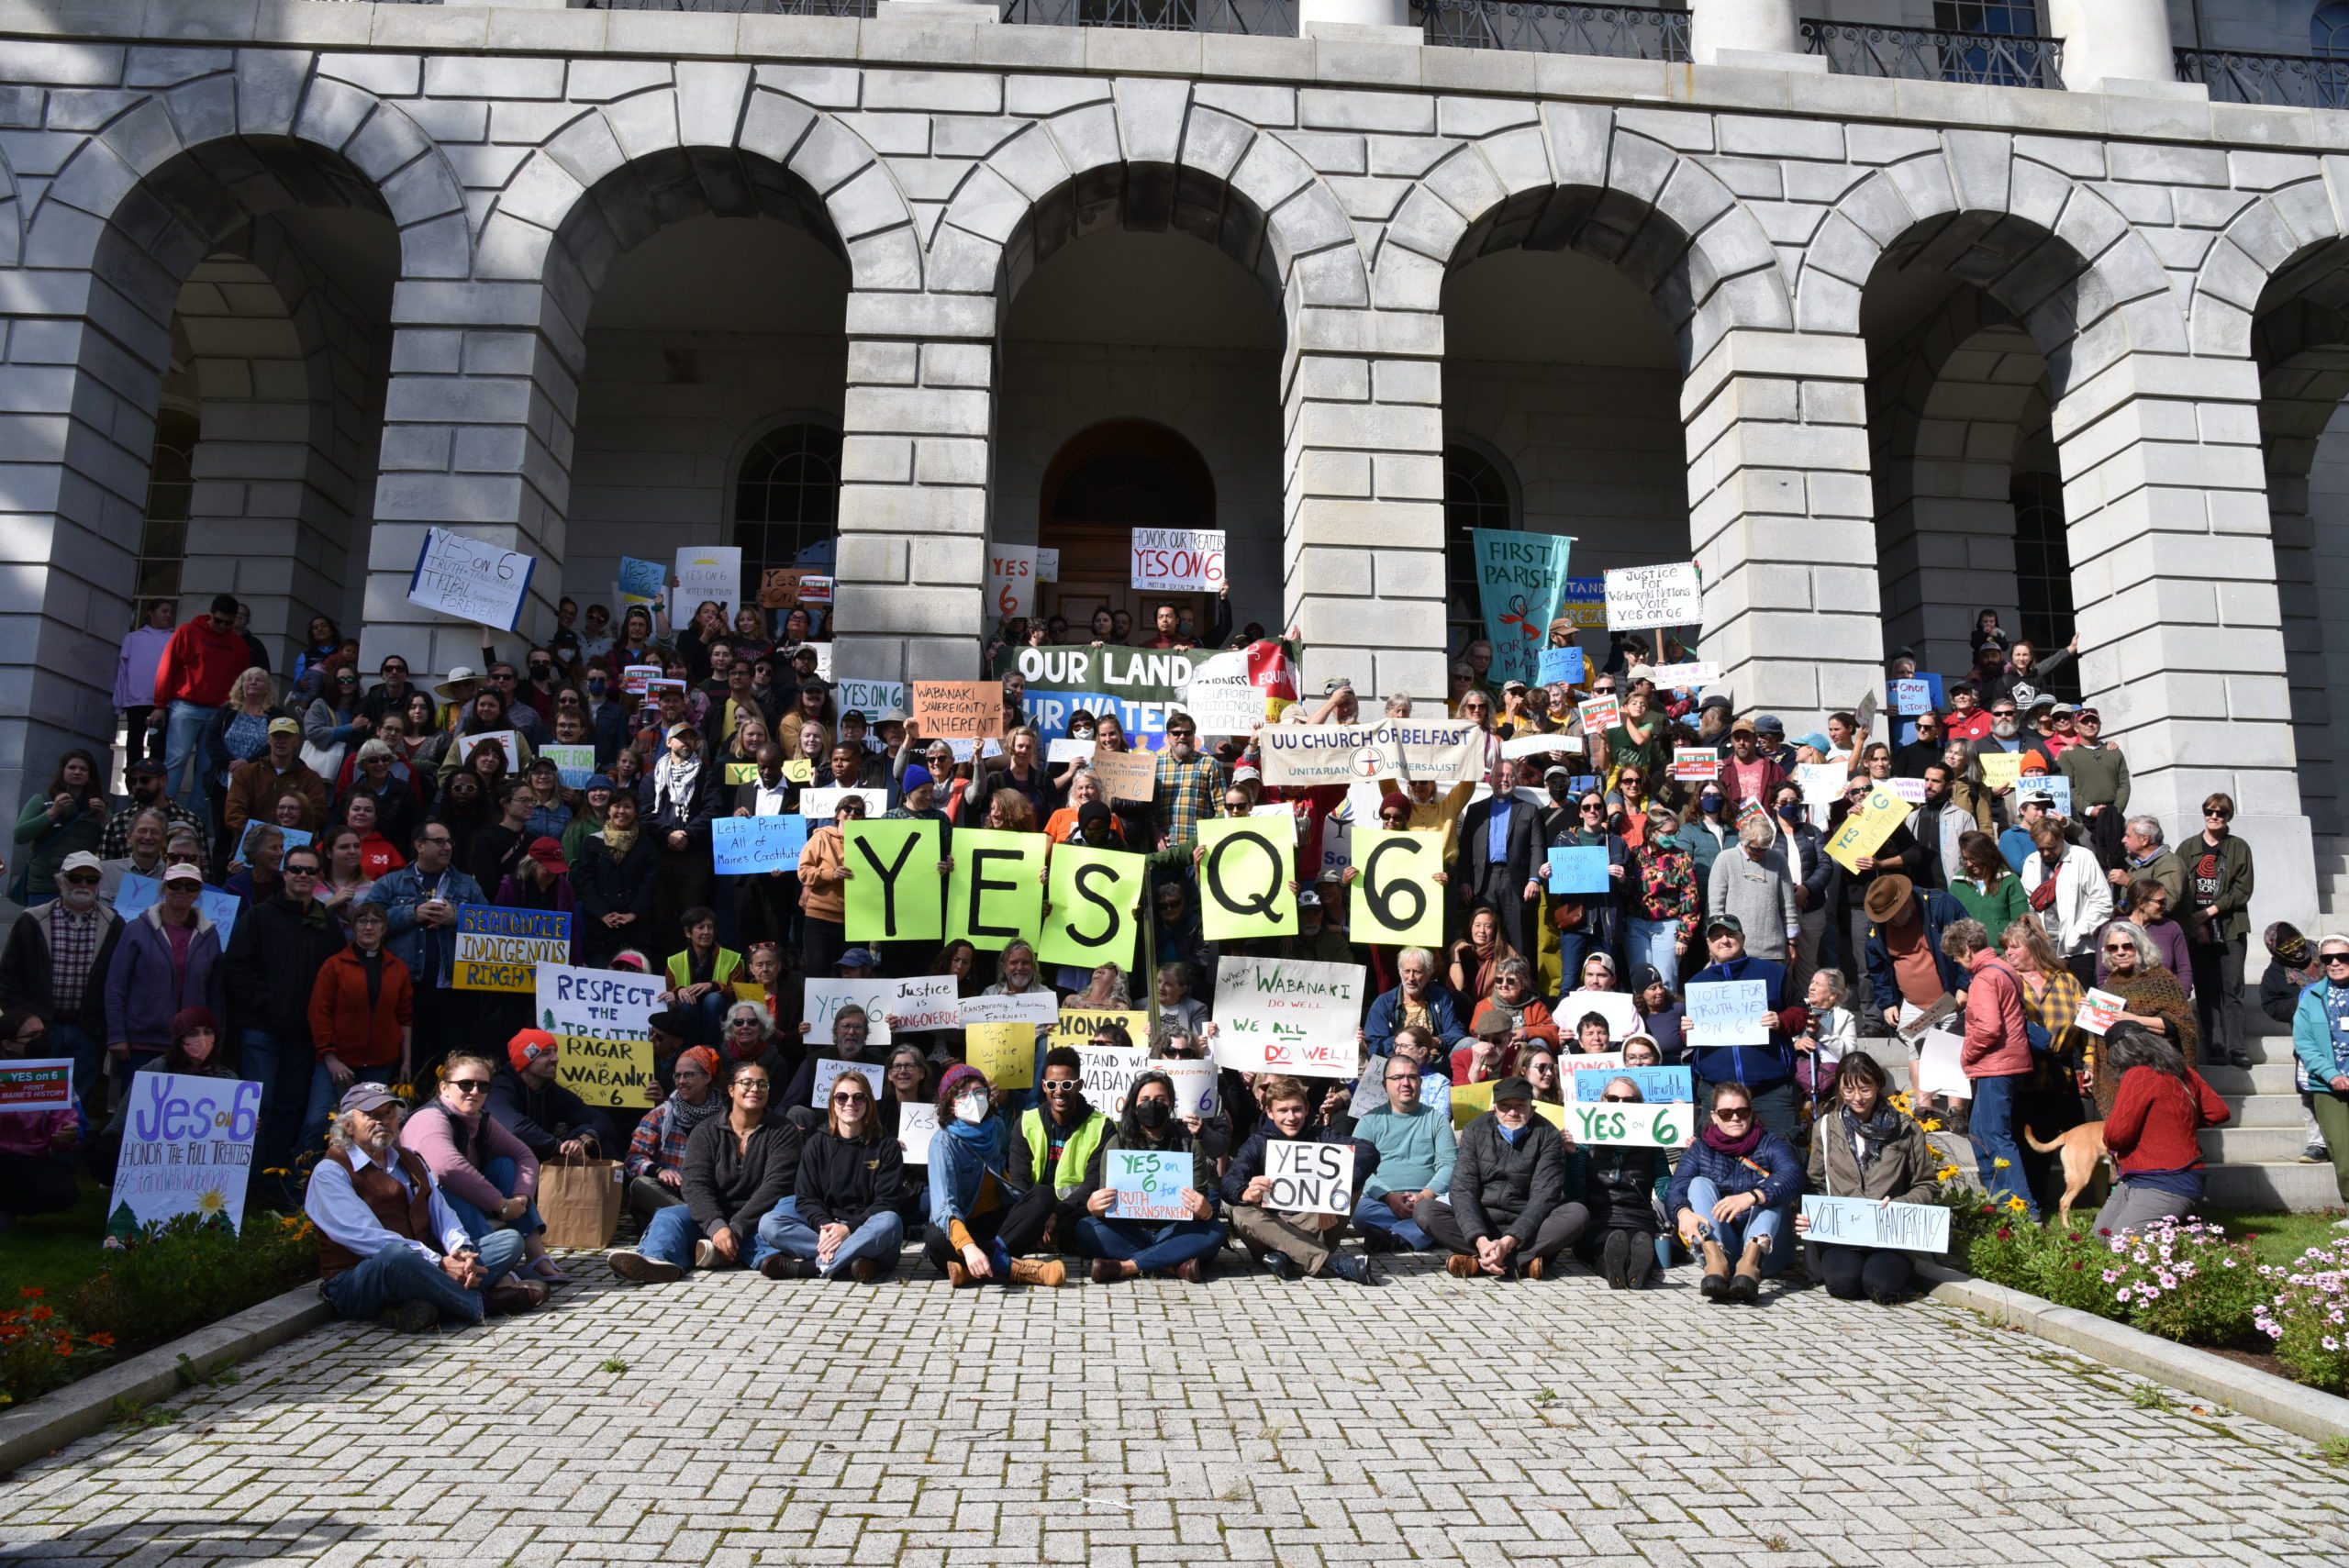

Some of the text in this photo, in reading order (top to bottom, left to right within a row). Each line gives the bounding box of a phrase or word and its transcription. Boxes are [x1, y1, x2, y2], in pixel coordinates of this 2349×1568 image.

[1133, 529, 1225, 551] HONOR OUR TREATIES
[437, 529, 518, 580] YES ON 6
[1490, 541, 1553, 565] FIRST
[428, 555, 463, 574] TRUTH
[993, 558, 1029, 577] YES
[1134, 549, 1222, 581] YES ON 6
[423, 569, 471, 597] TRIBAL
[685, 570, 727, 581] YES ON 6
[766, 570, 796, 588] Yes
[1485, 565, 1557, 589] PARISH
[1626, 567, 1678, 581] Justice
[714, 588, 733, 596] TRUTH
[1567, 582, 1605, 594] TAND
[998, 584, 1019, 615] 6
[1543, 649, 1577, 662] YES 6
[1019, 648, 1192, 687] OUR LAND
[841, 684, 903, 706] YES ON 6
[1204, 689, 1253, 700] SUPPORT
[920, 701, 987, 713] SOVEREIGNTY
[1023, 699, 1065, 730] UR
[1190, 700, 1264, 715] INDIGENOUS
[926, 717, 999, 733] INHERENT
[1201, 715, 1258, 729] PEOPLES
[1272, 728, 1470, 749] UU CHURCH OF BELFAST
[573, 750, 593, 768] FOR
[793, 761, 807, 779] 6
[1103, 769, 1149, 777] CONSTITUTION
[1288, 766, 1350, 776] UNITARIAN
[1132, 781, 1142, 796] 6
[2019, 777, 2054, 788] VOTE
[806, 792, 874, 815] Yes 6
[2053, 791, 2067, 799] ON
[717, 818, 788, 835] Let's Print
[730, 834, 767, 849] All of
[1838, 828, 1860, 850] YES
[1557, 853, 1588, 862] HONOR
[1557, 873, 1593, 883] HISTORY
[464, 909, 566, 938] RECOGNIZE
[557, 974, 655, 1007] RESPECT
[897, 982, 951, 998] Justice
[1256, 964, 1351, 999] WABANAKI
[1691, 984, 1765, 1002] VOTE FOR
[866, 995, 884, 1023] 6
[1268, 999, 1325, 1009] DO WELL
[1742, 1002, 1768, 1015] YES
[588, 1006, 618, 1021] THE
[984, 1024, 1011, 1038] Print
[1233, 1019, 1308, 1036] WE ALL
[1699, 1020, 1724, 1035] ON
[567, 1037, 633, 1060] RAGAR
[989, 1037, 1007, 1046] The
[1079, 1051, 1119, 1068] STAND
[1264, 1045, 1356, 1062] DO WELL
[826, 1062, 843, 1071] Let's
[983, 1056, 1024, 1077] Thing!
[11, 1071, 58, 1082] YES on 6
[1640, 1073, 1685, 1095] Truth
[34, 1089, 66, 1097] HISTORY
[610, 1089, 624, 1106] 6
[1199, 1088, 1212, 1111] 6
[137, 1075, 217, 1142] Yes
[227, 1081, 261, 1142] 6
[907, 1111, 935, 1131] Yes
[1575, 1107, 1626, 1140] YES
[1652, 1108, 1678, 1145] 6
[124, 1140, 252, 1165] HONOR THE FULL TREATIES
[1120, 1153, 1181, 1174] YES on
[1275, 1144, 1341, 1180] YES
[1141, 1173, 1180, 1196] 6 for
[1270, 1177, 1350, 1211] ON 6
[1804, 1201, 1946, 1249] VOTE for TRANSPARENCY
